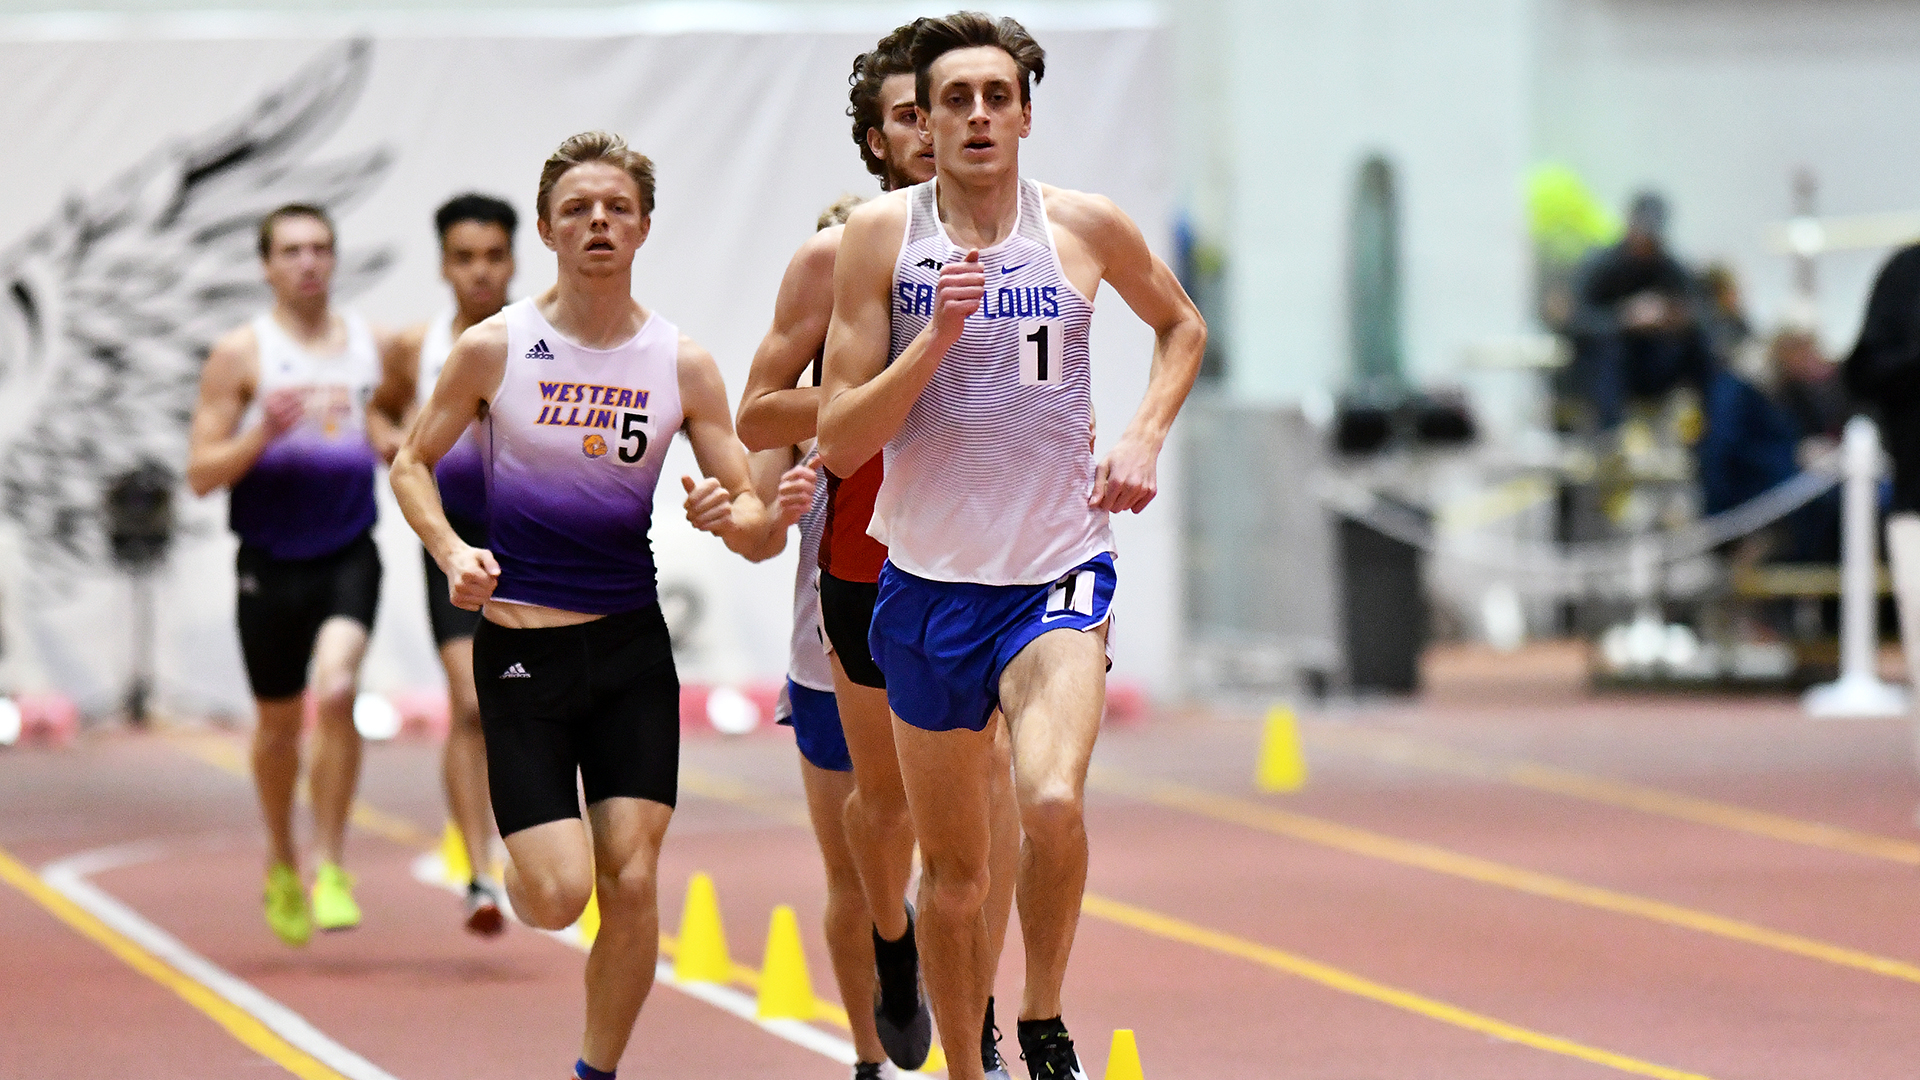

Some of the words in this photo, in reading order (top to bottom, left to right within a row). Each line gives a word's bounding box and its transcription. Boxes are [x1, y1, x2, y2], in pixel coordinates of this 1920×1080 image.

[984, 286, 1060, 318] LOUIS
[525, 352, 555, 361] adidas
[1027, 325, 1048, 381] 1
[538, 381, 650, 410] WESTERN
[534, 405, 617, 431] ILLIN
[618, 412, 648, 463] 5
[1055, 574, 1077, 610] 1
